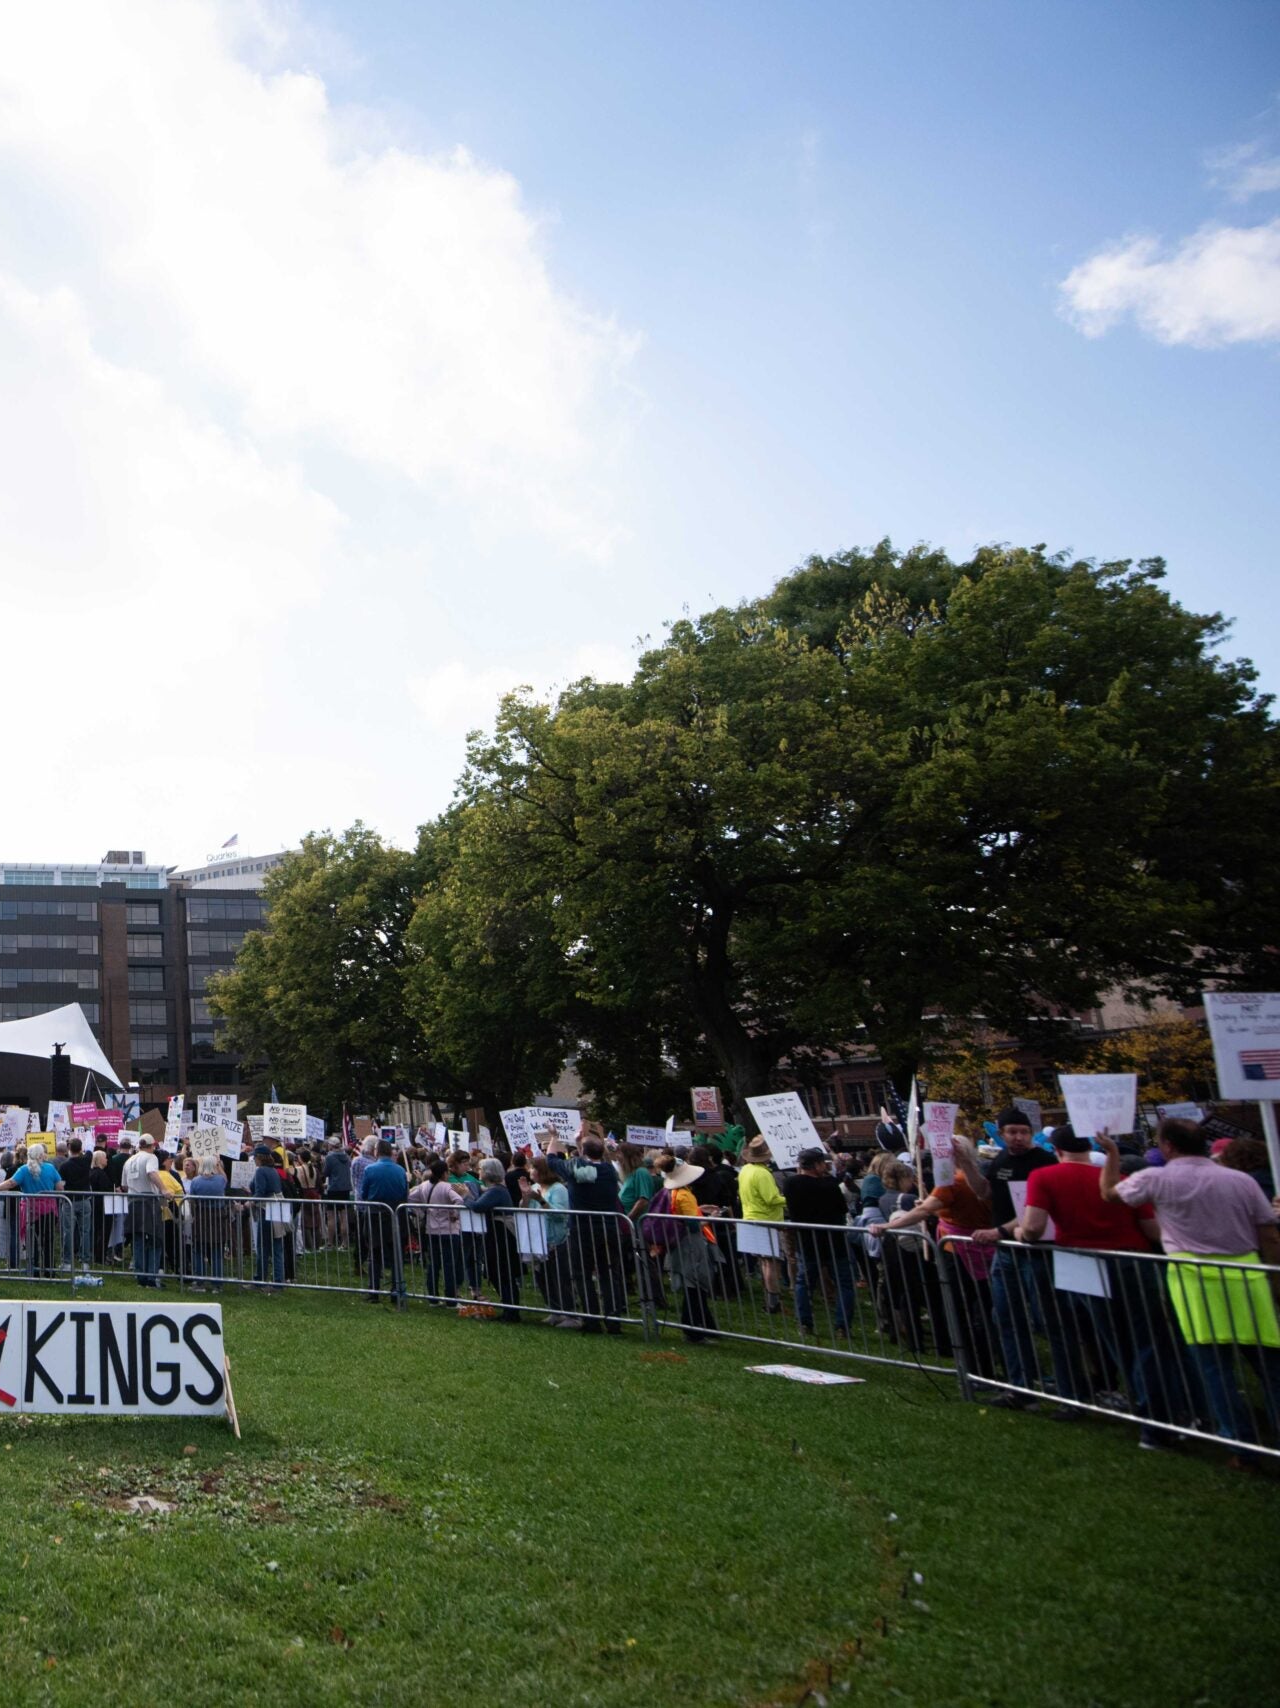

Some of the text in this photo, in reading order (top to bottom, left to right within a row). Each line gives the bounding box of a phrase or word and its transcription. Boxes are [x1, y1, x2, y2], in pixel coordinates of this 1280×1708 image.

[206, 850, 238, 862] Quarles
[200, 1112, 219, 1126] NOBEL
[221, 1118, 242, 1134] PRIZE
[194, 1127, 218, 1139] OMG
[195, 1137, 220, 1149] GOP
[197, 1145, 221, 1156] WTF
[24, 1309, 224, 1406] KINGS
